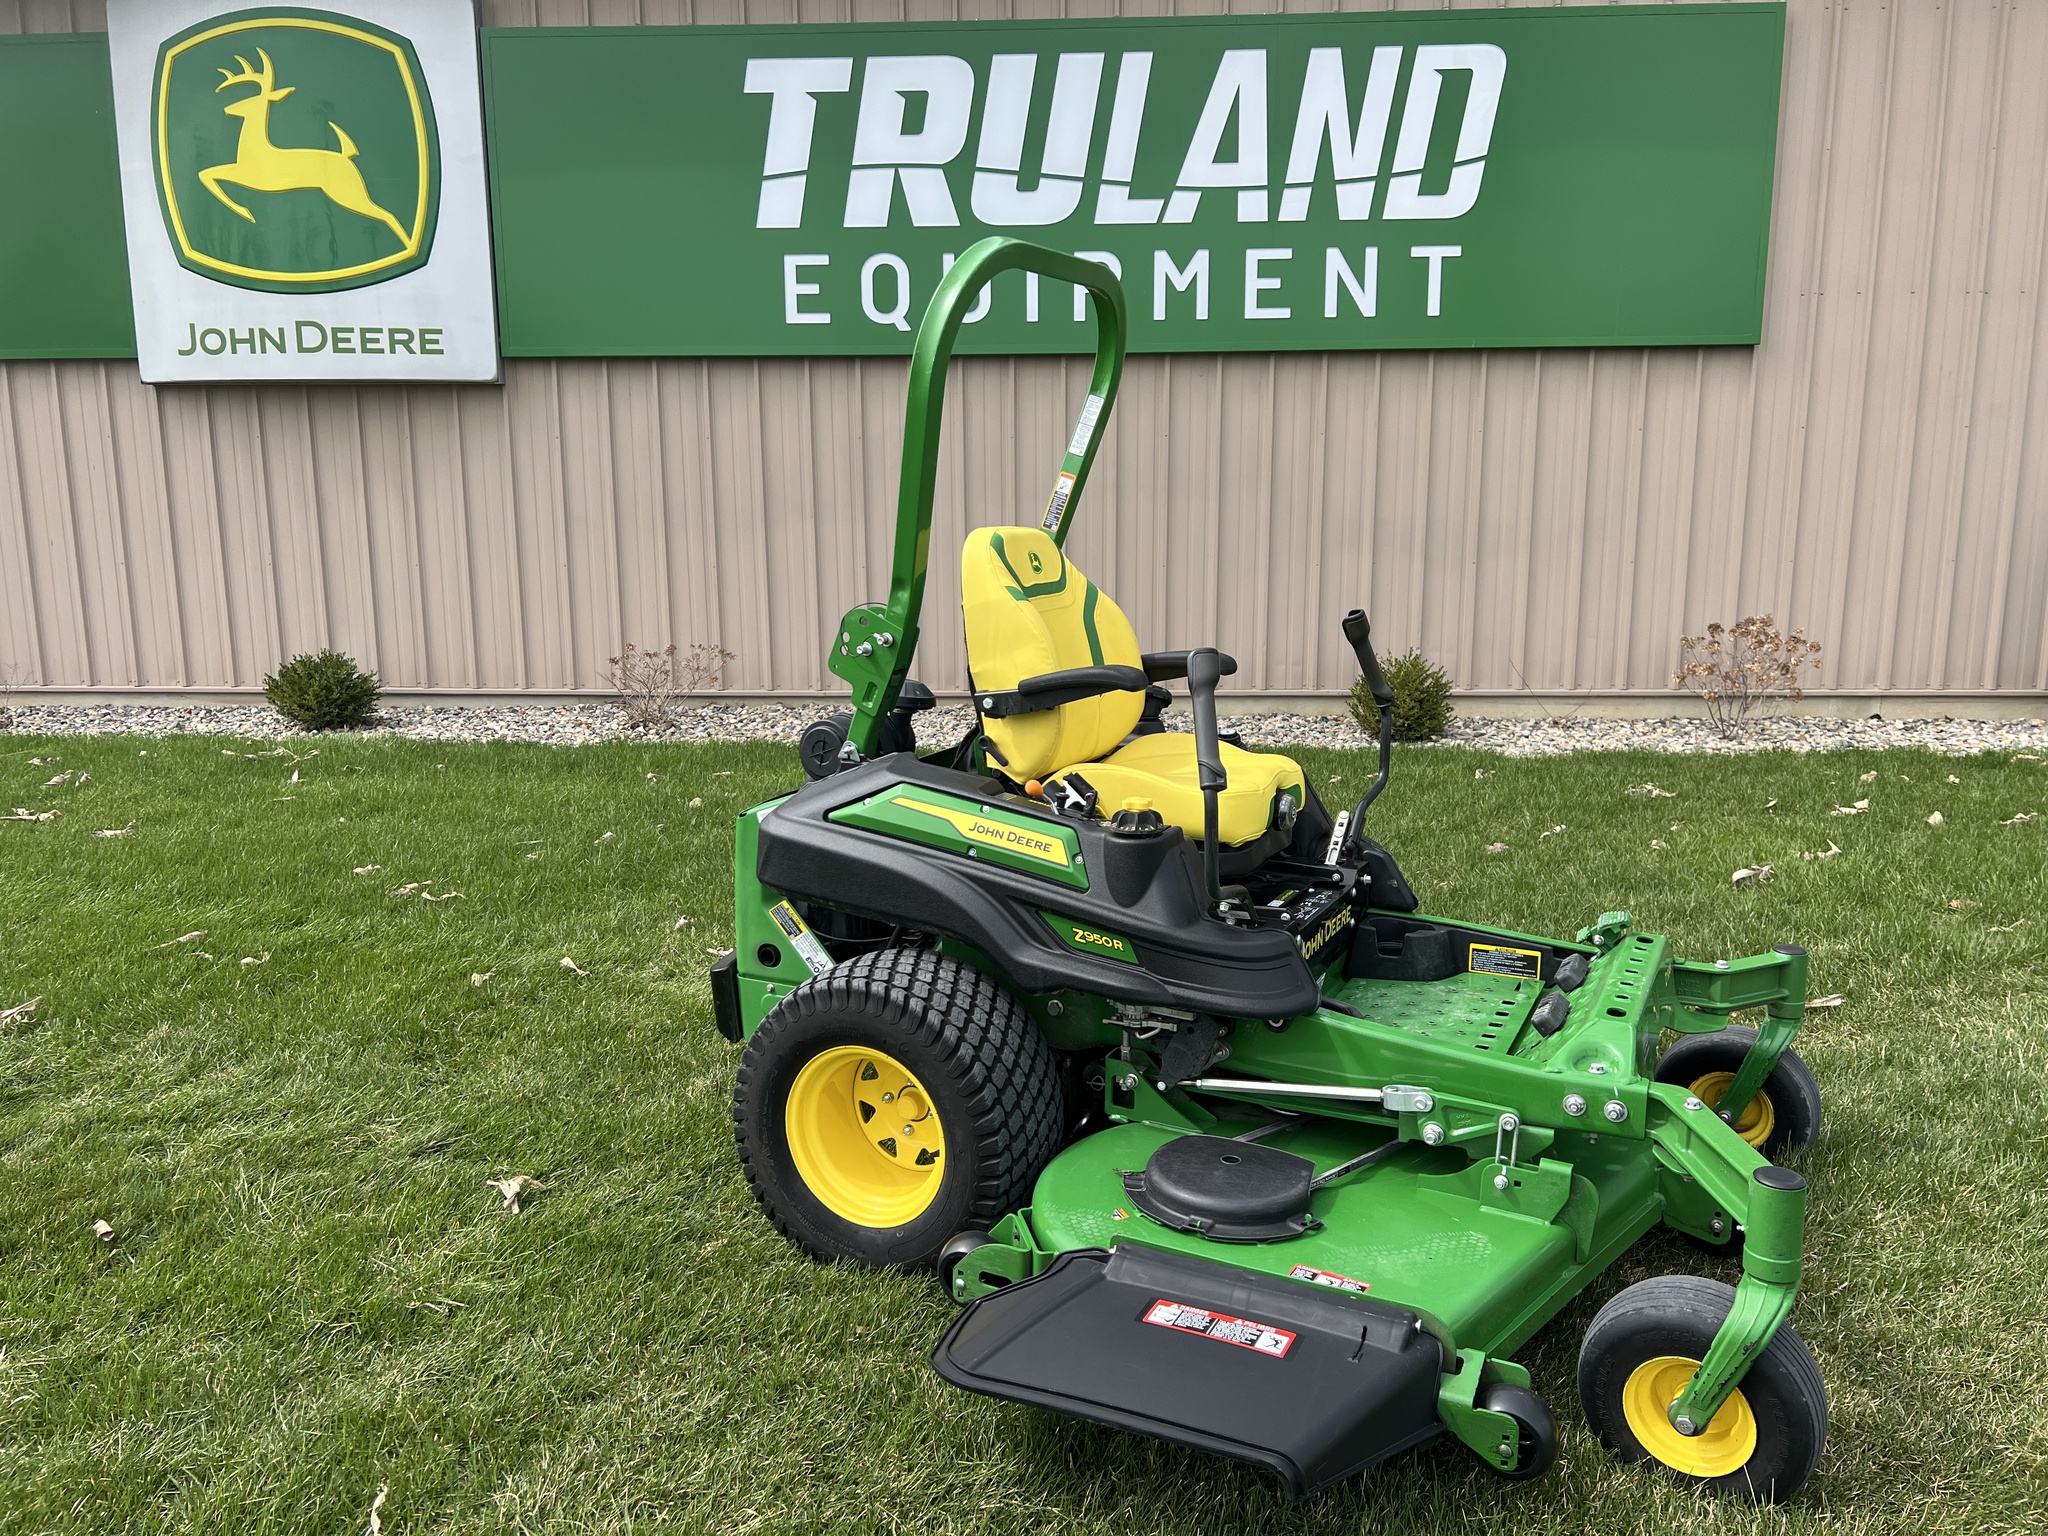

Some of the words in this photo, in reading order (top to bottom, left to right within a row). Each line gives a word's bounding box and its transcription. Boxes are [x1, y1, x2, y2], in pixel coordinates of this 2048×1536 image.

[743, 43, 1507, 229] TRULAND
[178, 322, 287, 356] JOHN
[294, 320, 445, 355] DEERE
[968, 821, 1006, 841] JOHN
[1007, 831, 1053, 853] DEERE
[1324, 905, 1351, 941] DEERE
[1179, 1304, 1211, 1316] DANGER
[1243, 1320, 1276, 1333] PELIGRO
